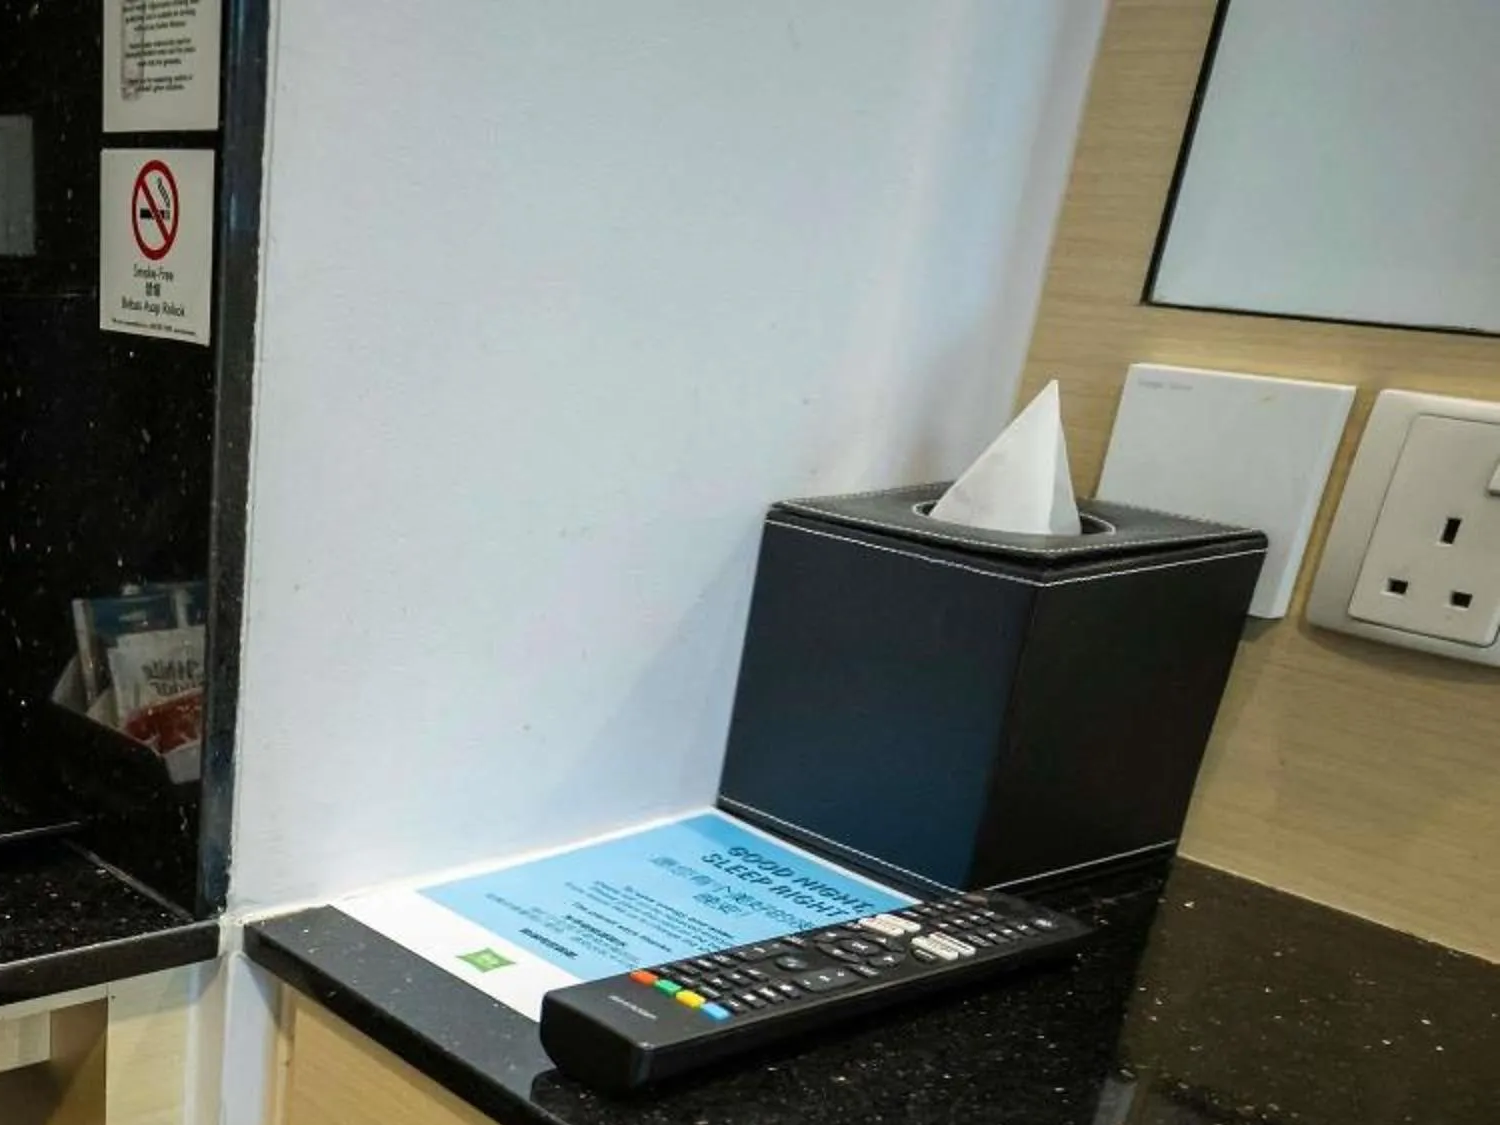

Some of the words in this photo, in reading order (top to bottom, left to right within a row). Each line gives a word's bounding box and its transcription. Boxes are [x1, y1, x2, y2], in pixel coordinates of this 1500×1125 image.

[701, 852, 774, 885] SLEEP
[769, 884, 850, 917] RIGHT
[728, 846, 795, 878] GOOD
